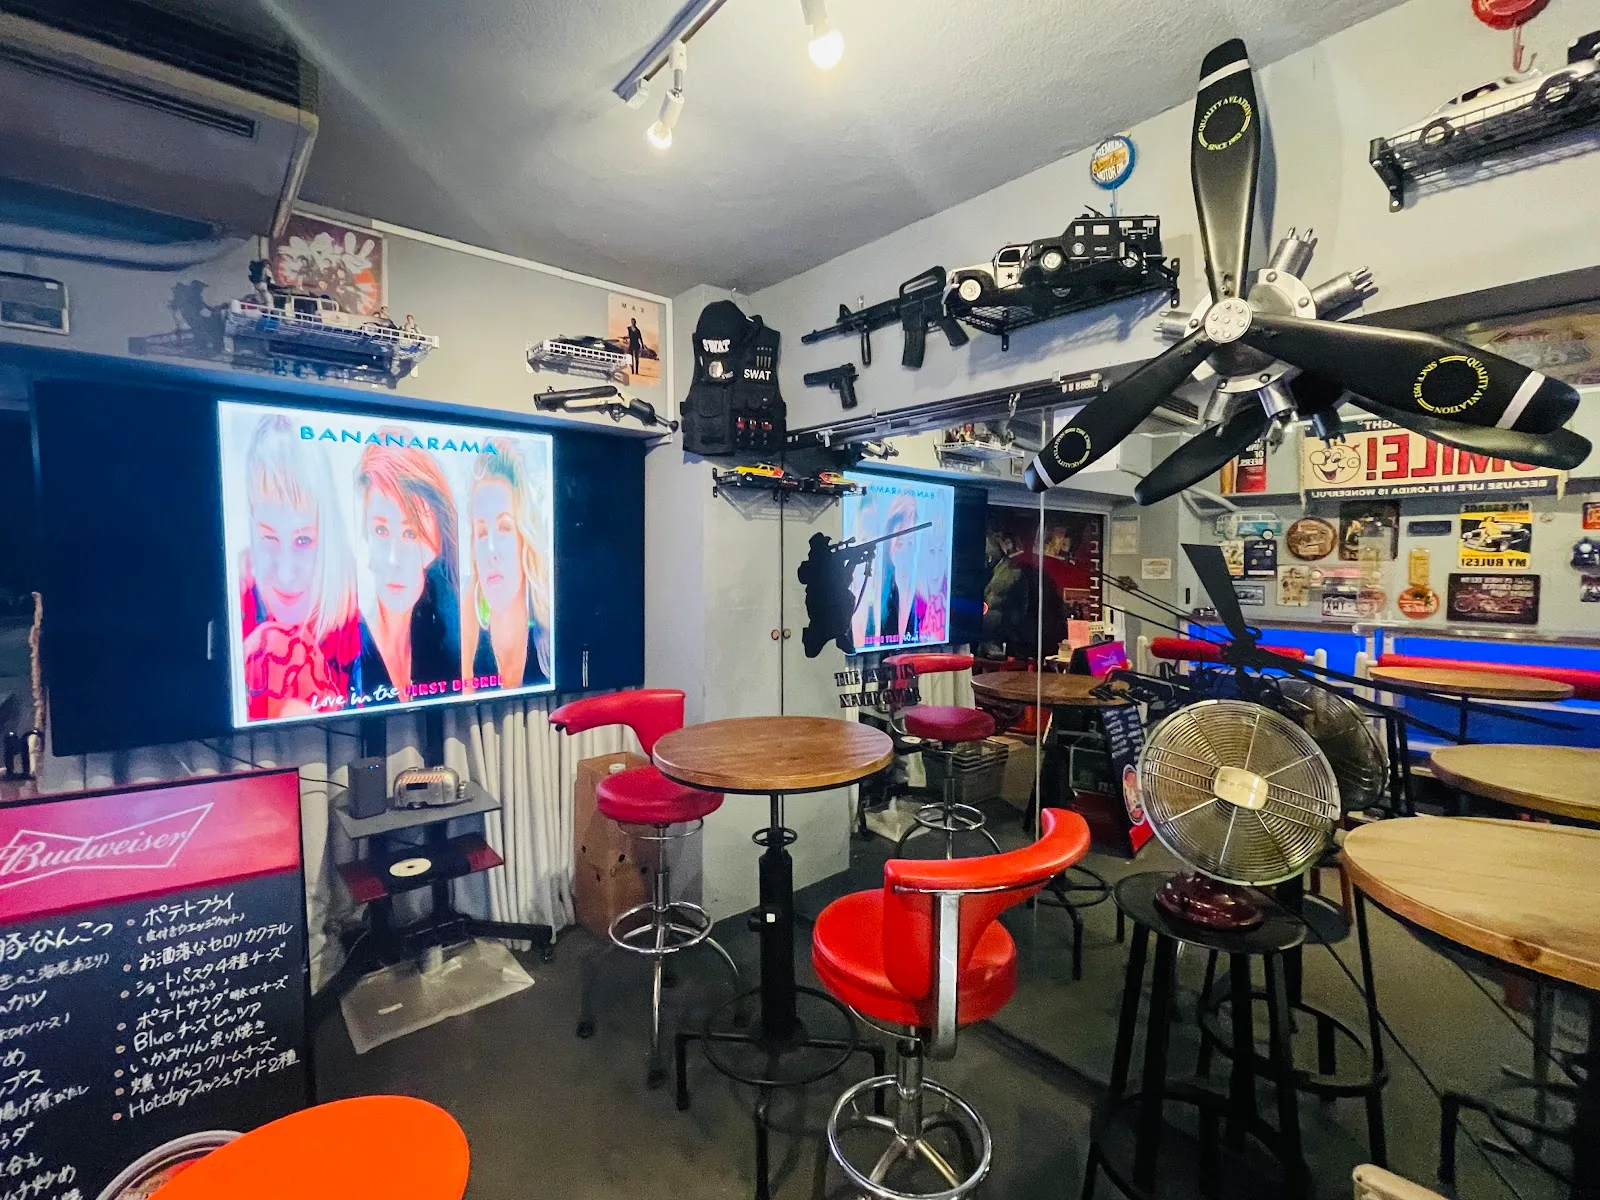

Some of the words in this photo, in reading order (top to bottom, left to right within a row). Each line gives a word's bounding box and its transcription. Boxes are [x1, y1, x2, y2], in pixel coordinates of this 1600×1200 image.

[702, 338, 731, 353] SWAT
[744, 369, 772, 381] SWAT
[1467, 357, 1489, 390] QUALITY
[1433, 389, 1483, 414] AVIATION
[300, 425, 499, 456] BANANARAMA
[310, 695, 346, 710] Love
[350, 686, 372, 705] in
[373, 684, 401, 701] the
[403, 681, 448, 697] FIRST
[0, 830, 190, 876] Budweiser
[142, 891, 234, 927] ポテトフライ
[134, 1030, 175, 1052] Blue
